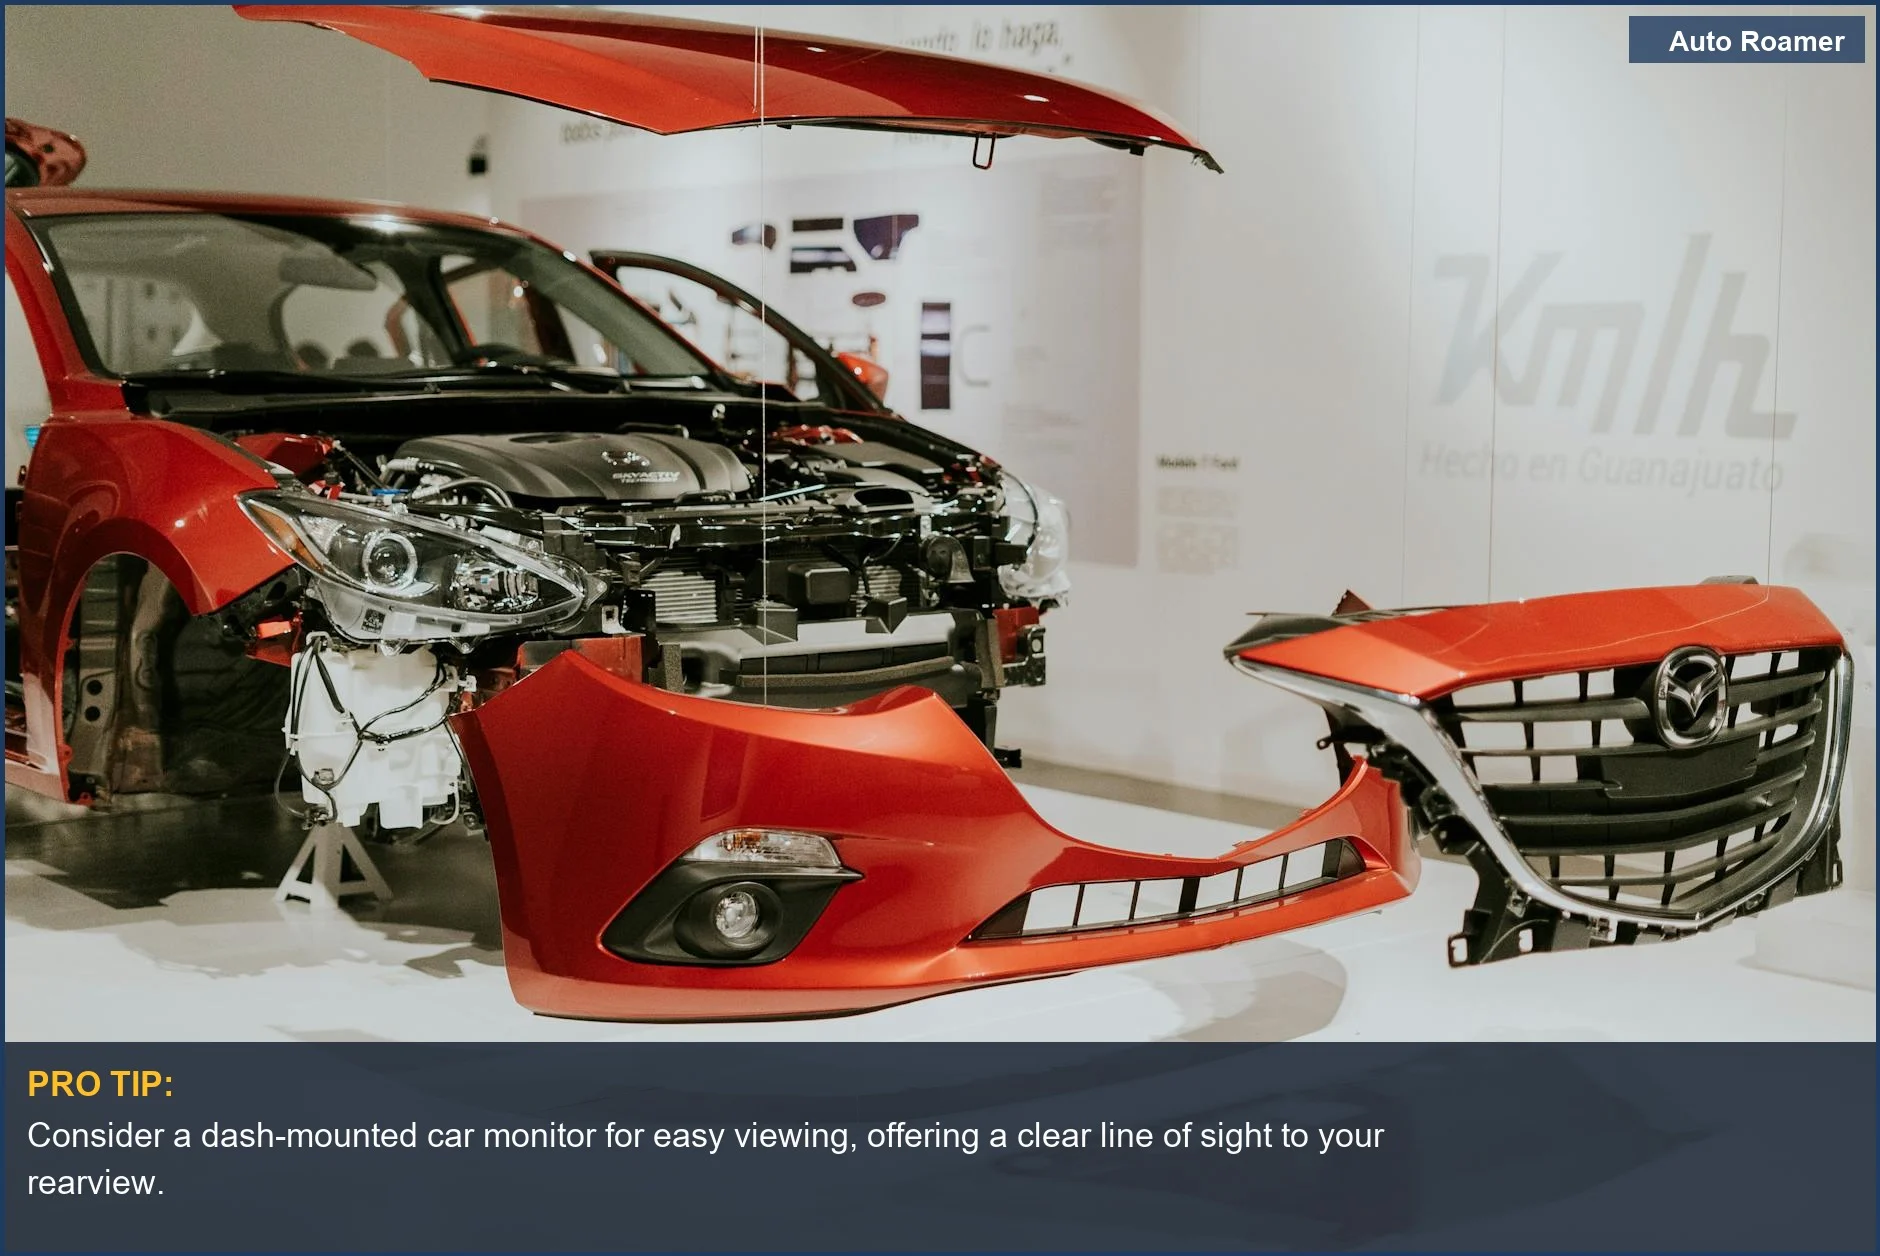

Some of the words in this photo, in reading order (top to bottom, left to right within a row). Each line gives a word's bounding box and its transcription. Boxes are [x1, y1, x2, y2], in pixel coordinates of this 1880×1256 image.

[612, 471, 681, 479] SKYACTIV
[1417, 440, 1519, 484] Hecho
[1529, 450, 1568, 484] en
[1576, 444, 1784, 498] Guanajuato
